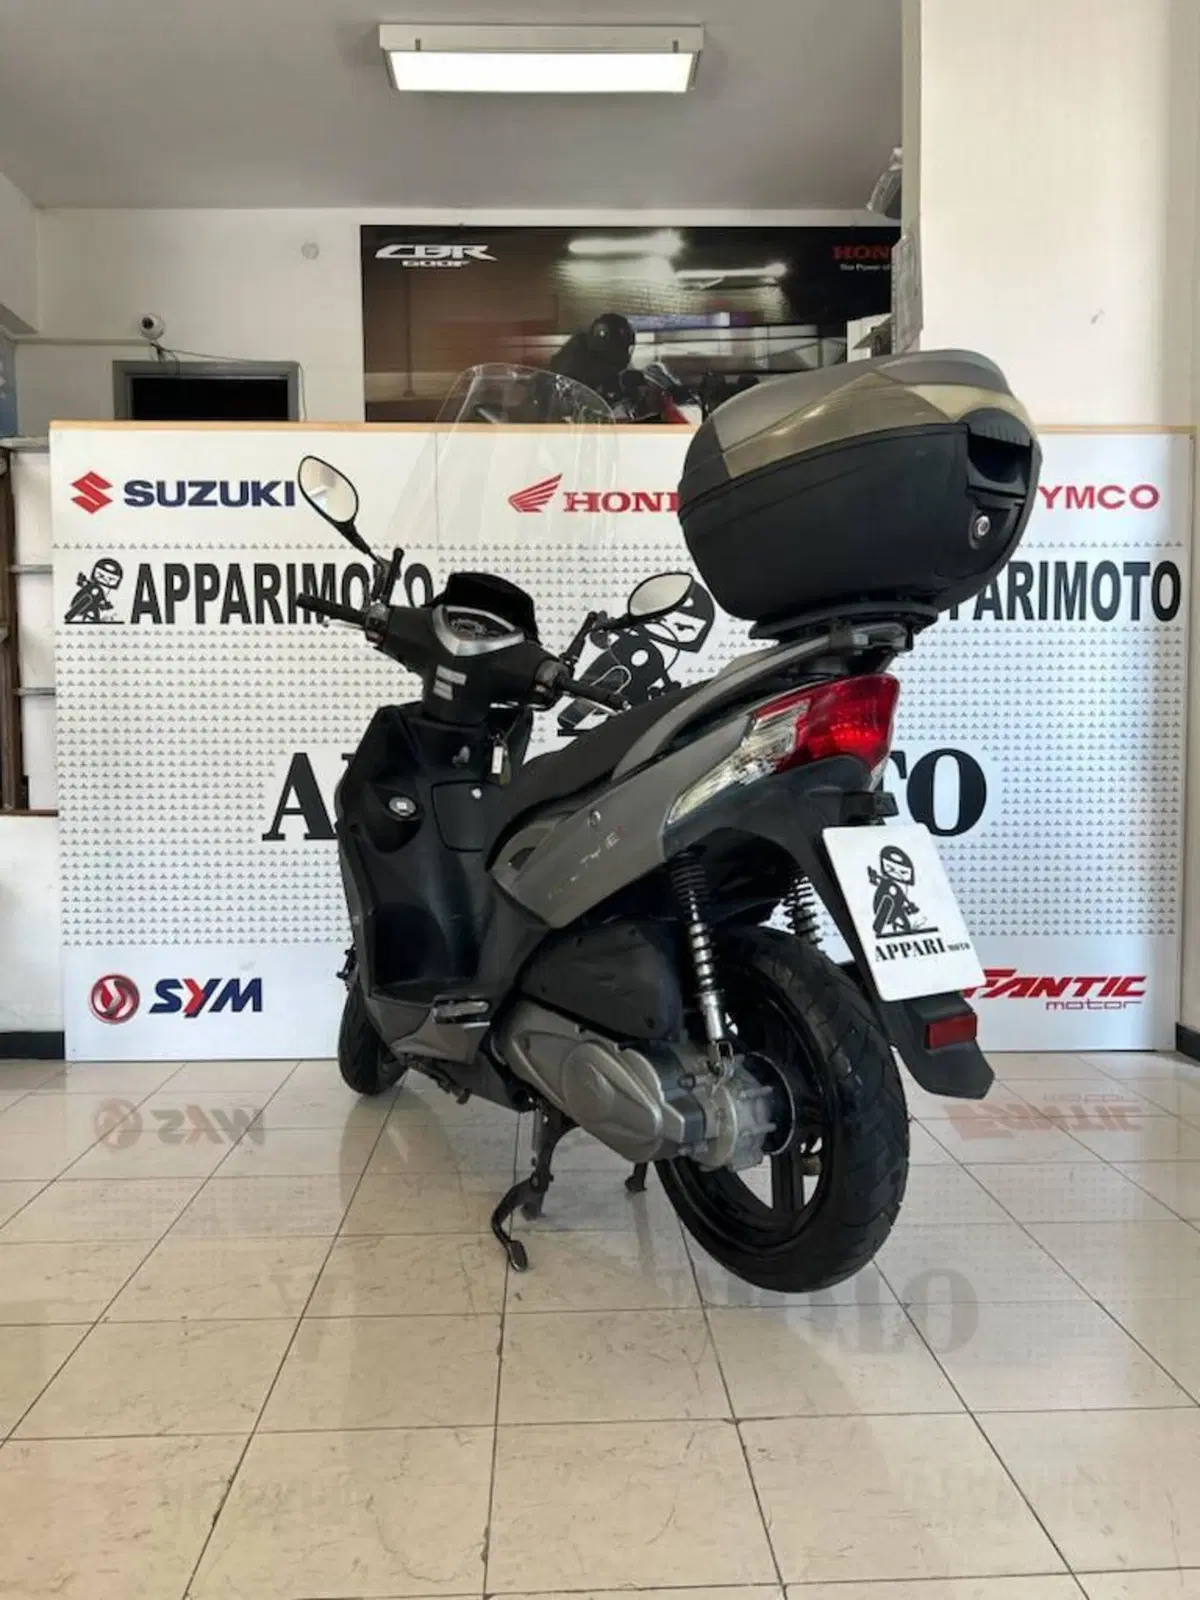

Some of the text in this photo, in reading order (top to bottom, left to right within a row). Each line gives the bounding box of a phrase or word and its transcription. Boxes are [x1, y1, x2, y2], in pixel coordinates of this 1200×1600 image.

[374, 243, 498, 260] CBR
[831, 245, 891, 259] HON
[123, 479, 296, 508] SUZUKI
[1037, 484, 1160, 510] YMCO
[130, 562, 434, 625] APPARIMOO
[949, 560, 1182, 622] ARIMOTO
[875, 937, 945, 961] APPARI
[149, 977, 263, 1018] SYM
[1045, 999, 1142, 1010] motor
